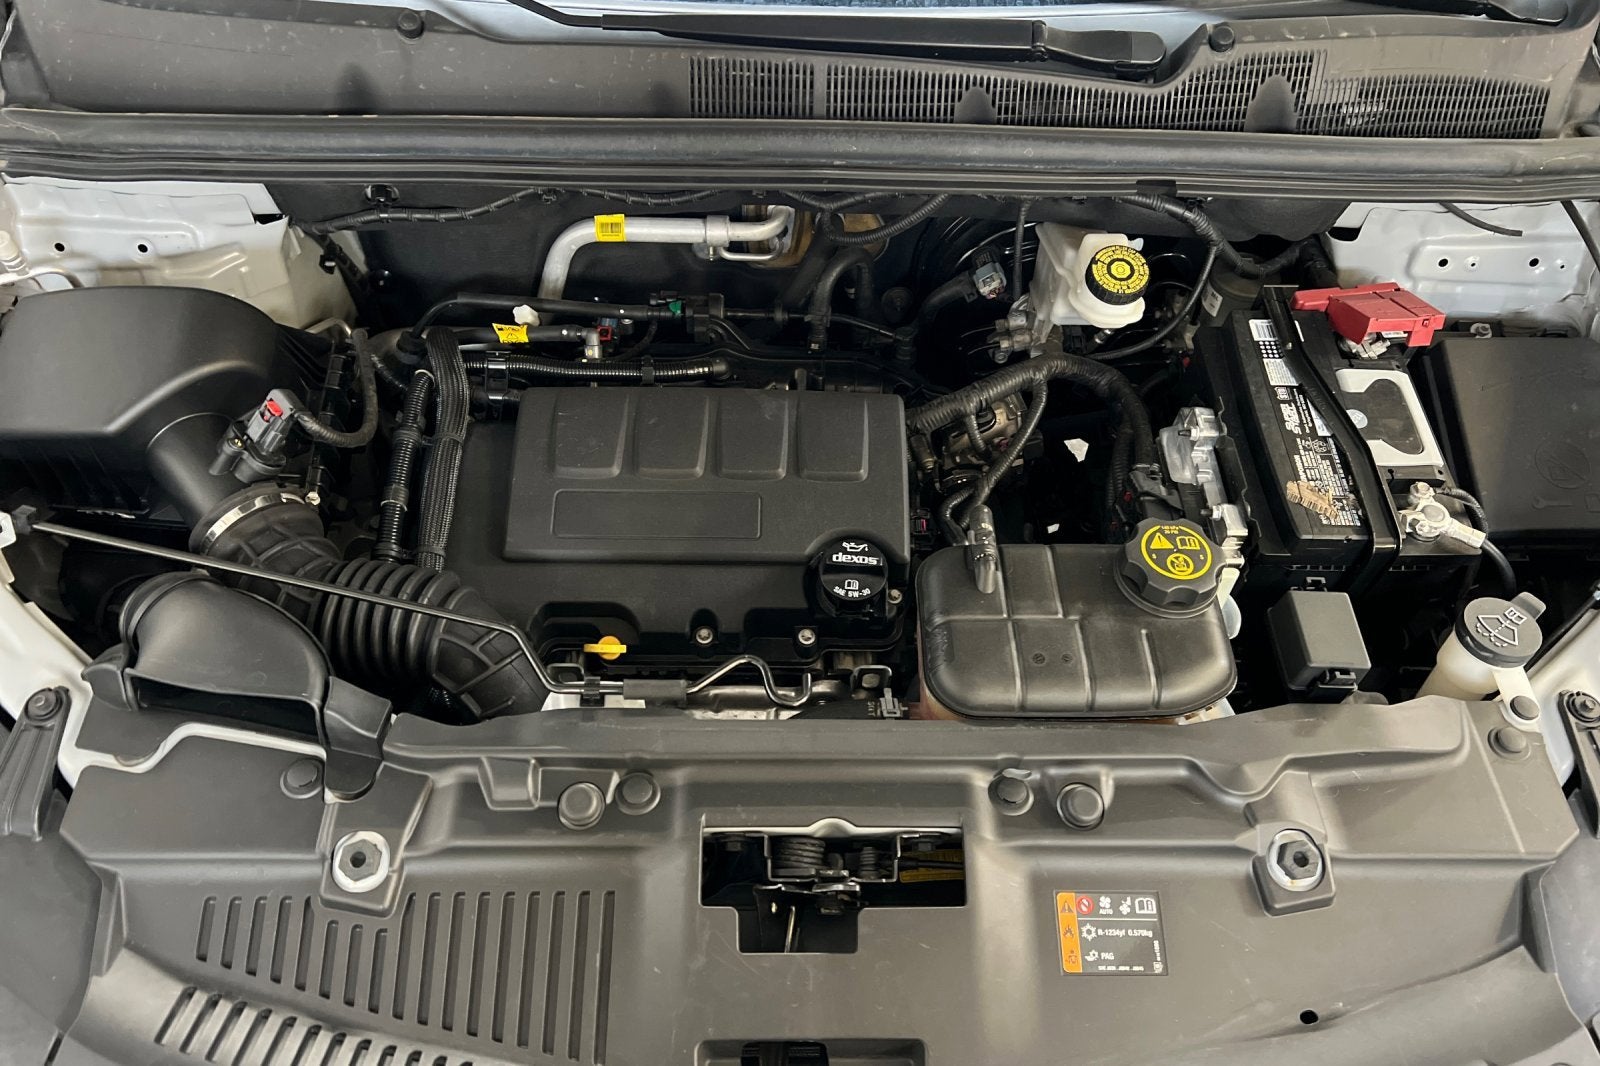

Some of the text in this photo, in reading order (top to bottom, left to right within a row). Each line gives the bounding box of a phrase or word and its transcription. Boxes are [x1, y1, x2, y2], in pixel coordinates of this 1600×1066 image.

[832, 552, 879, 565] dexos
[833, 586, 871, 598] SAE 5W-30
[1101, 952, 1115, 960] PAG
